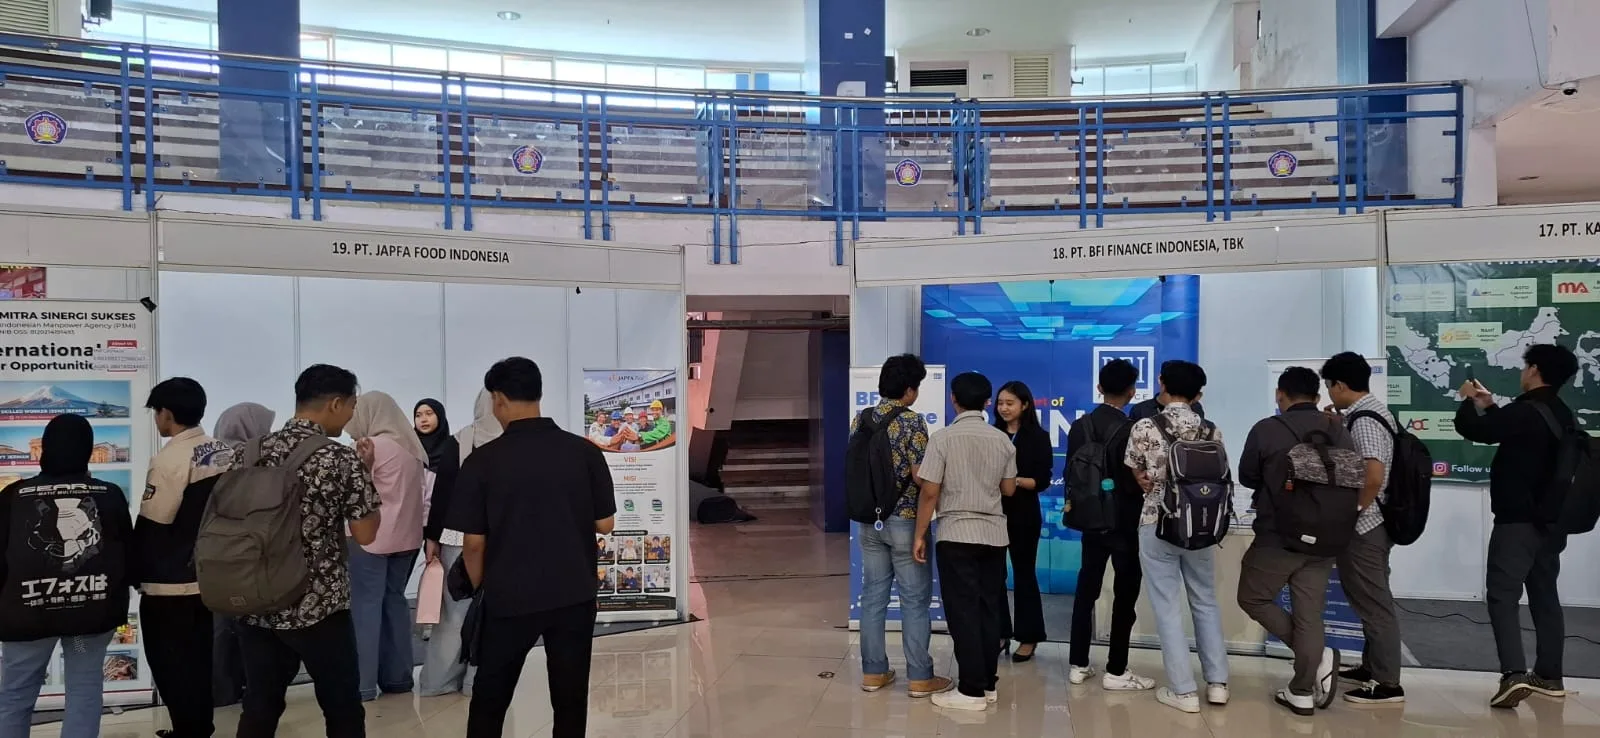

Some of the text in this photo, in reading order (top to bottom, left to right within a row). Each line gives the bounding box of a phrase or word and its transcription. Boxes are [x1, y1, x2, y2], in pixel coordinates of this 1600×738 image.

[1539, 223, 1558, 237] 17.
[1562, 222, 1581, 236] PT.
[332, 242, 510, 263] 19. PT. JAPFA FOOD INDONESIA
[1053, 237, 1244, 260] 18. PT. BFI FINANCE INDONESIA, TBK
[0, 311, 137, 321] MITRA SINERGI SUKSES
[0, 342, 101, 357] rnationa
[1051, 397, 1065, 407] of
[1451, 464, 1483, 473] Follow
[19, 483, 88, 495] GEAR
